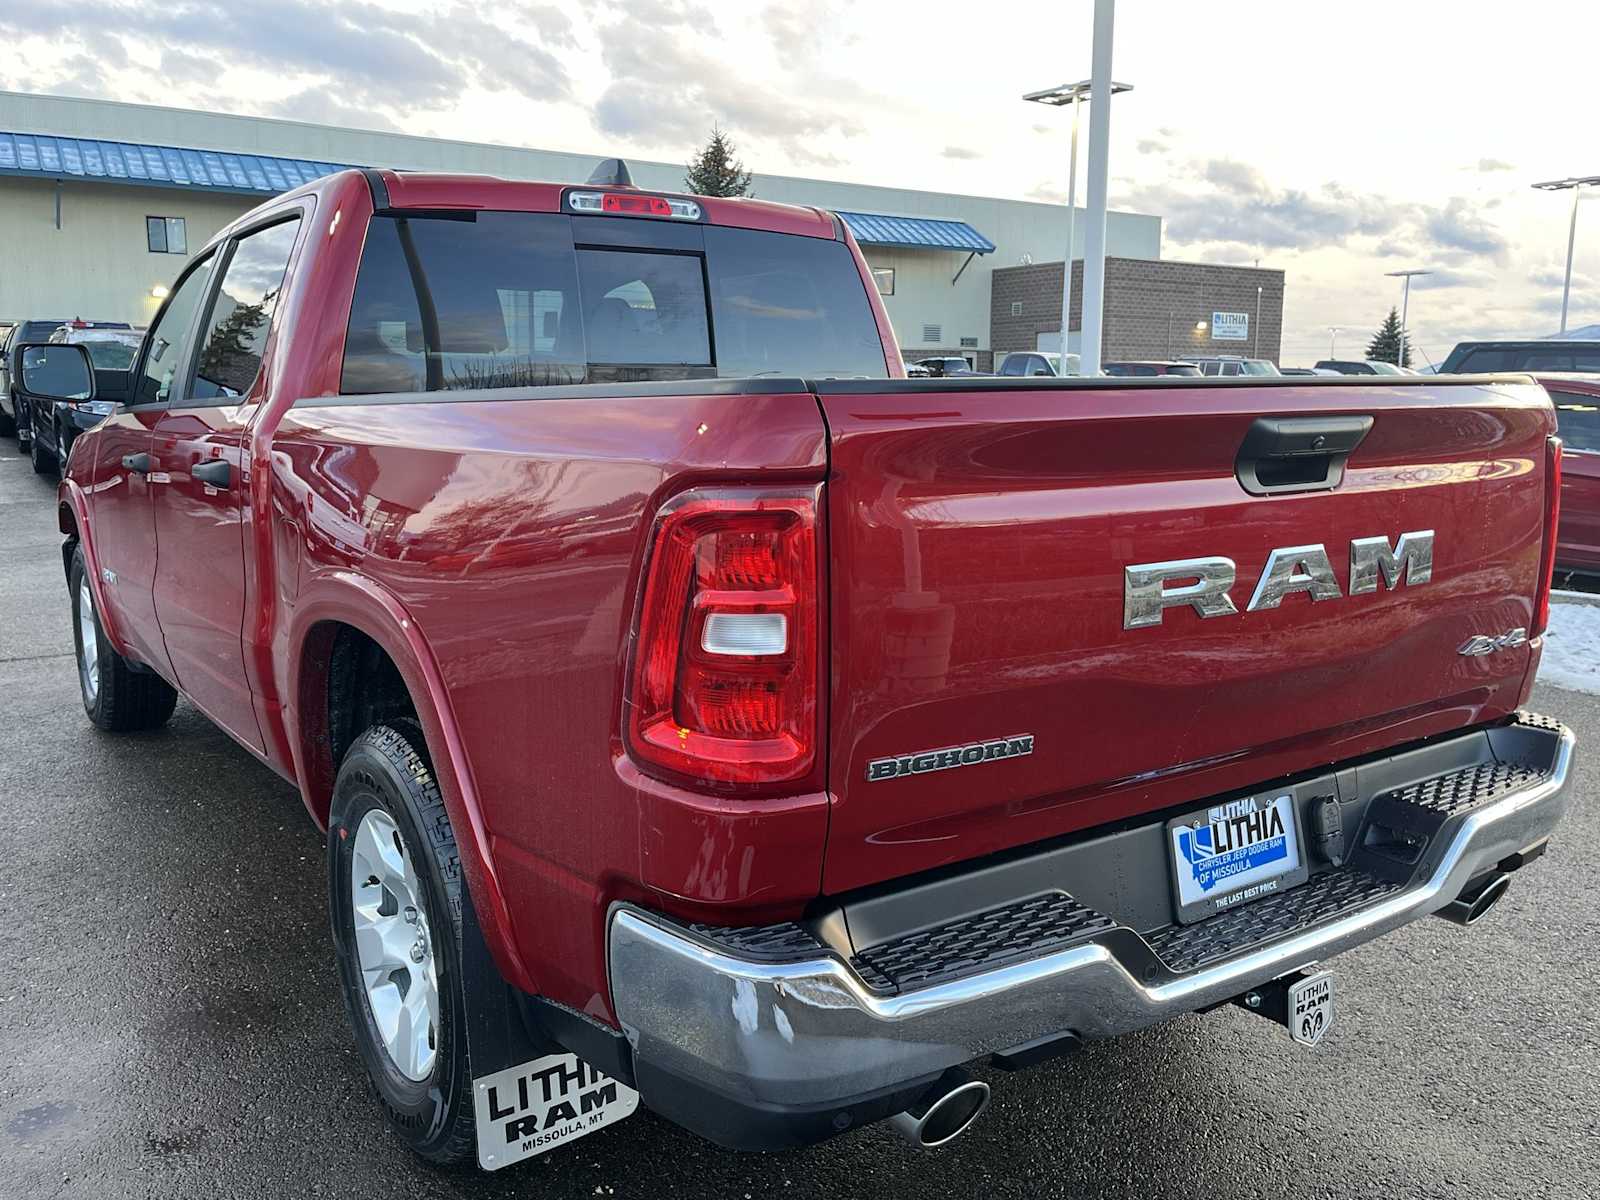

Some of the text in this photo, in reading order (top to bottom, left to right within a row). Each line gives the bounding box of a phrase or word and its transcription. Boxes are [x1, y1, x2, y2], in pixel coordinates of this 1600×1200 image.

[1221, 314, 1246, 325] LITHIA
[1124, 530, 1435, 630] RAM
[1219, 797, 1258, 820] LITHIA
[1213, 805, 1285, 855] LITHIA
[1199, 838, 1283, 872] CHRYSLER JEEP DODGE RAM
[1200, 859, 1252, 885] OF MISSOULA
[1216, 880, 1278, 908] THE LAST BEST PRICE
[1296, 992, 1329, 1015] RAM
[1297, 981, 1329, 1004] LITHIA
[505, 1082, 617, 1144] RAM
[522, 1111, 605, 1152] MISSOULA, MT
